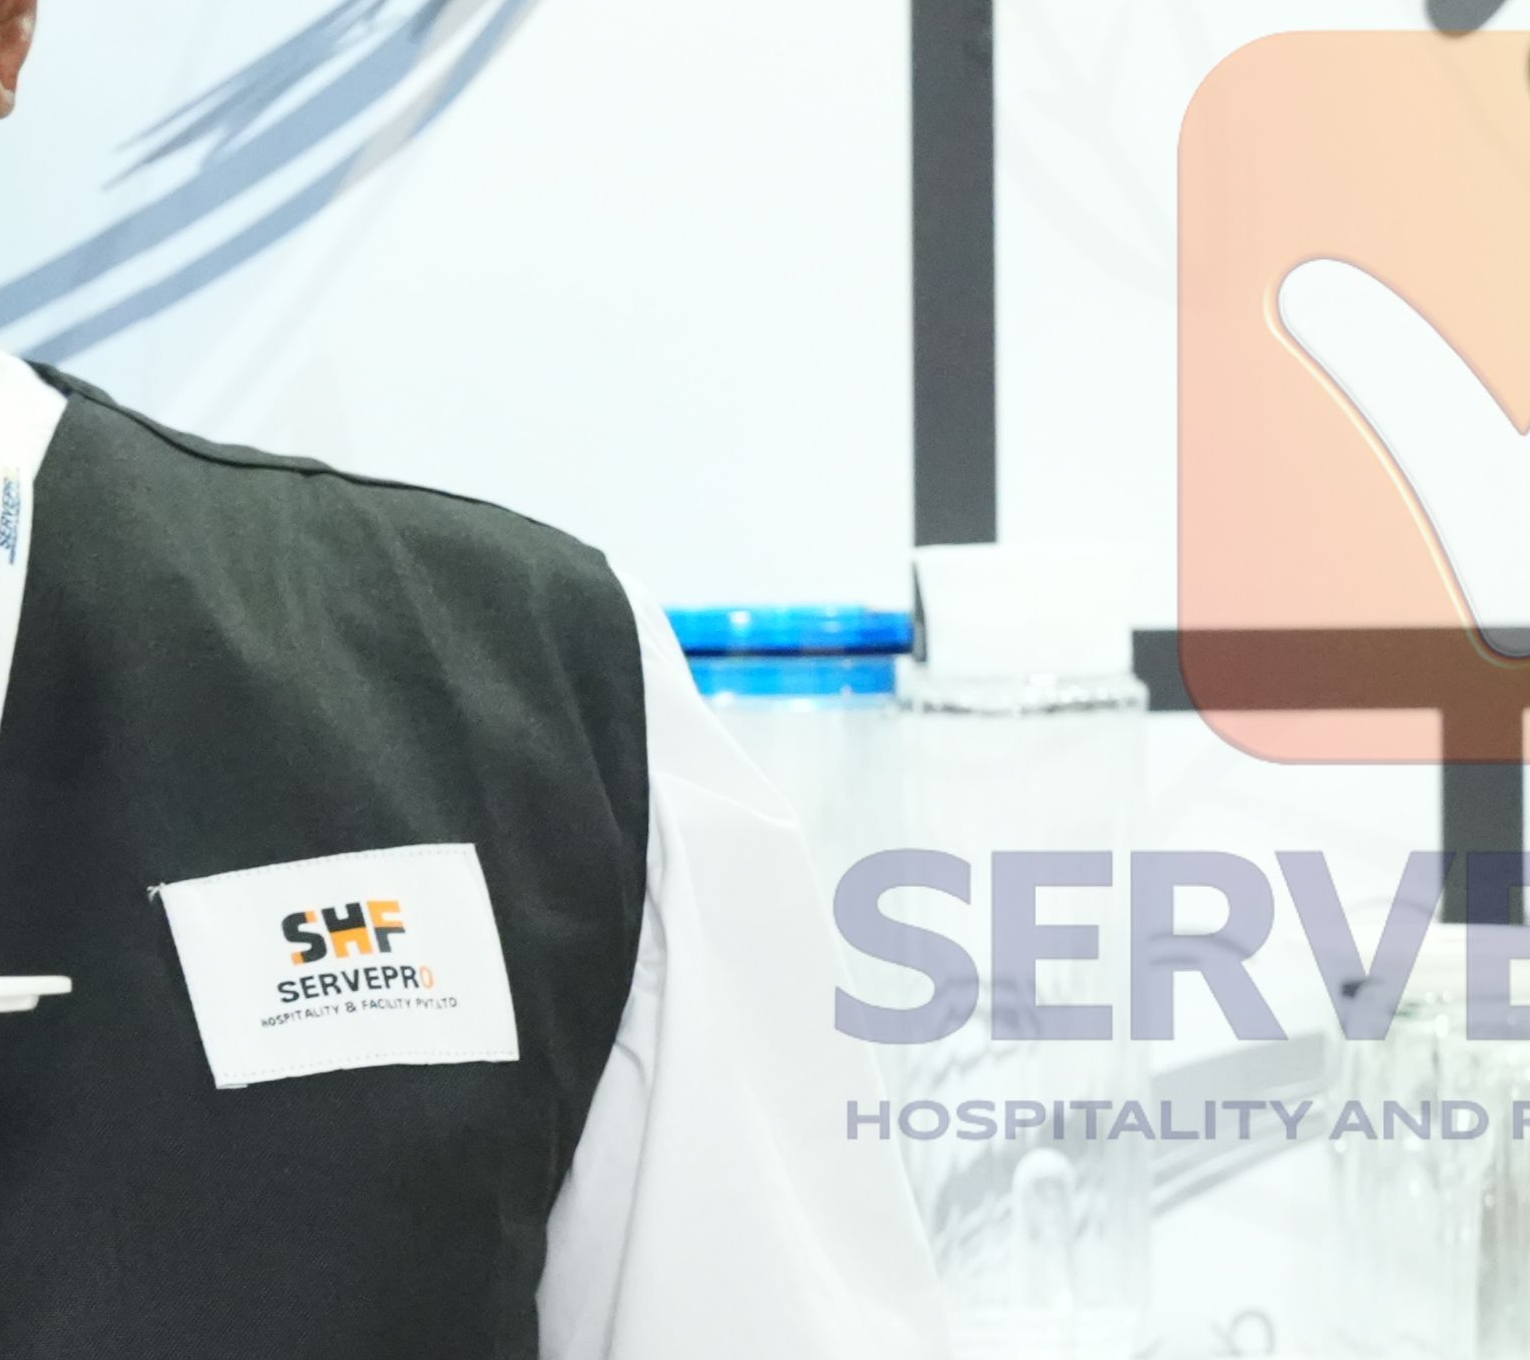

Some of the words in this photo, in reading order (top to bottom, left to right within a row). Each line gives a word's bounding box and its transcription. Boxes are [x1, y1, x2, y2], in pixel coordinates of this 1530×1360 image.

[280, 899, 407, 967] SHF
[276, 964, 436, 1004] SERVEPRO
[260, 1004, 339, 1029] HOSPITALITY
[344, 1000, 358, 1014] &
[361, 997, 412, 1012] FACILITY
